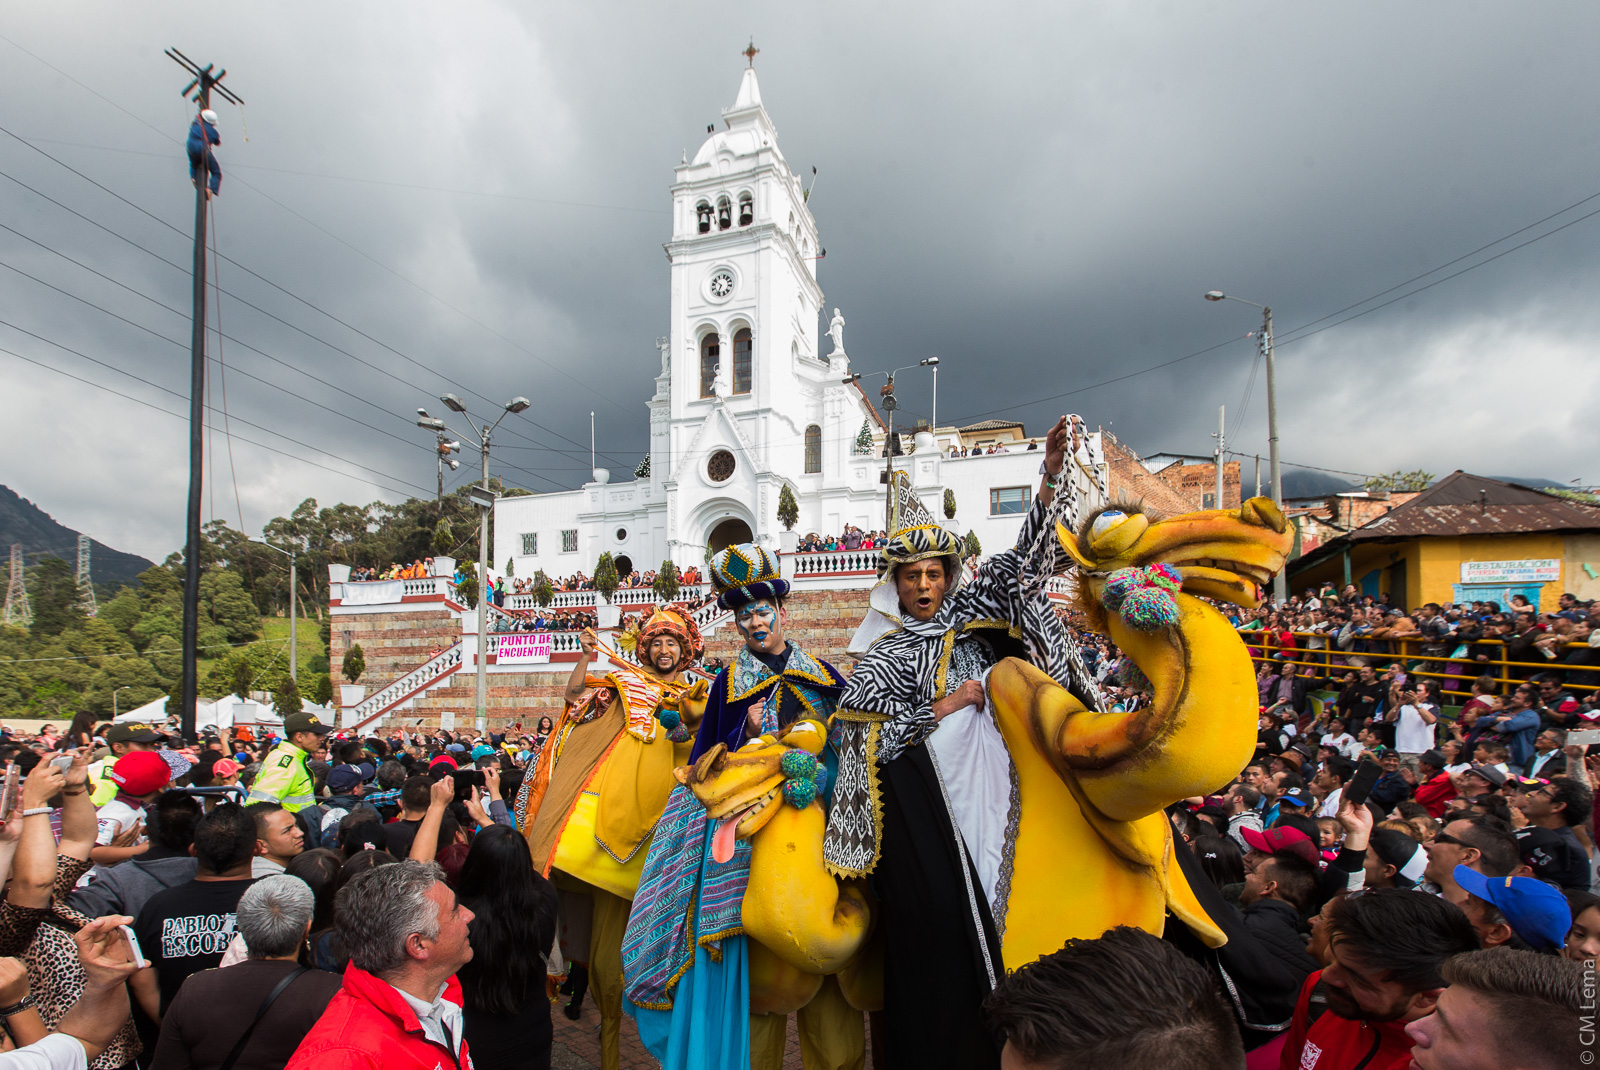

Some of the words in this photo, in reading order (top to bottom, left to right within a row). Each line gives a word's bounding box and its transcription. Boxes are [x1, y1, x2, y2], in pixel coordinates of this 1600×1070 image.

[501, 635, 536, 646] PUNTO
[538, 633, 552, 644] DE
[498, 645, 550, 658] ENCUENTRO
[162, 914, 221, 937] PABLO
